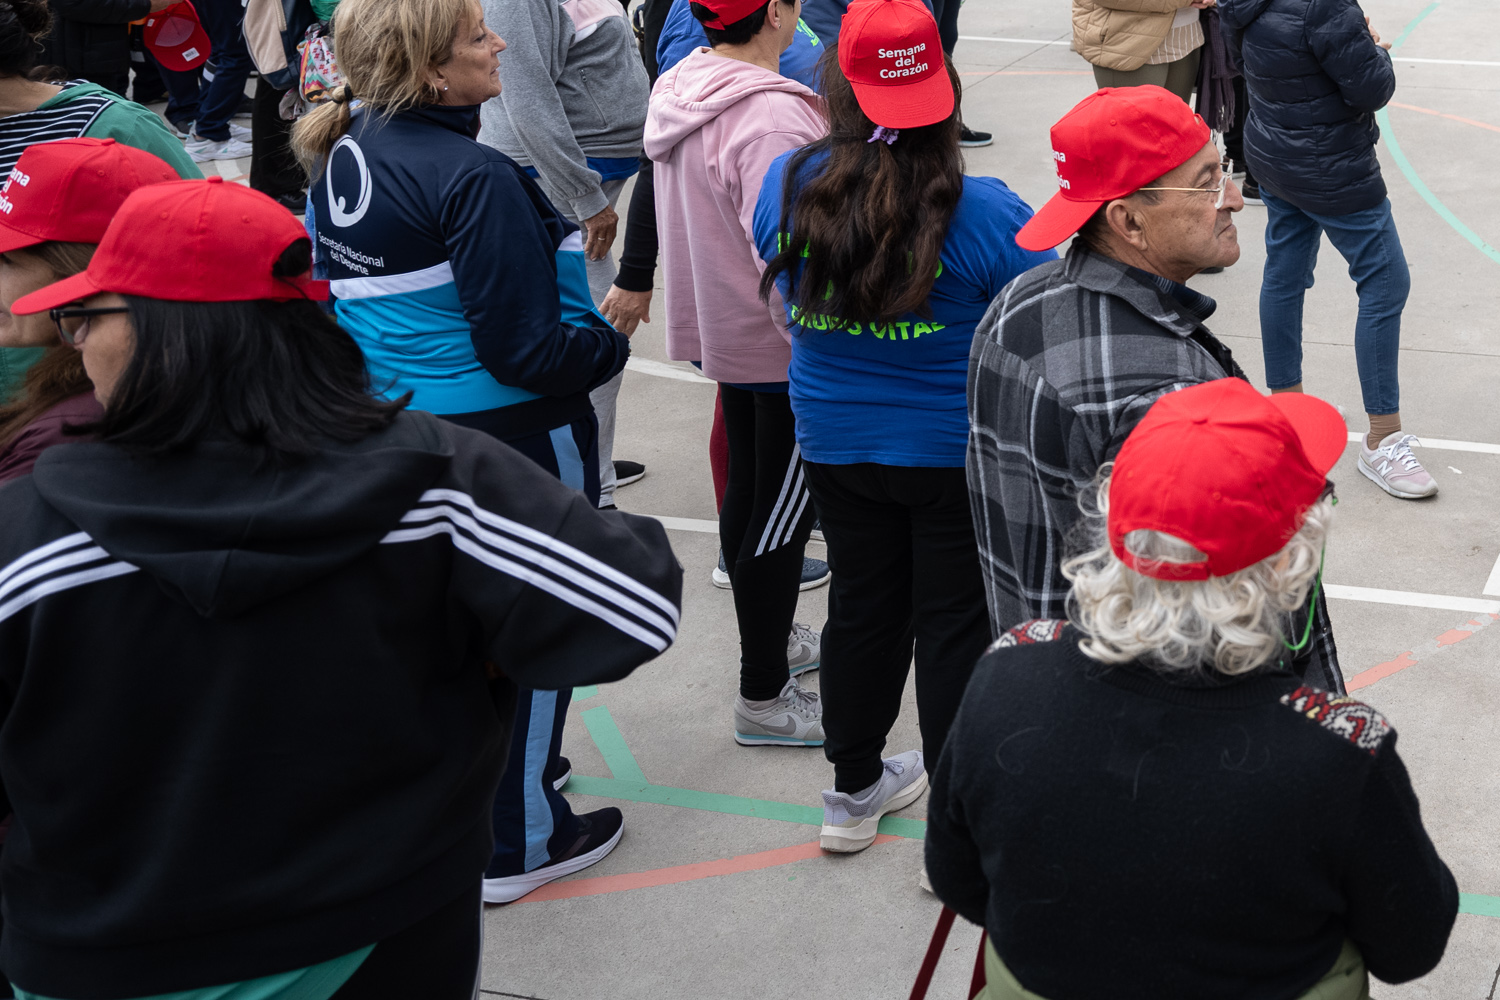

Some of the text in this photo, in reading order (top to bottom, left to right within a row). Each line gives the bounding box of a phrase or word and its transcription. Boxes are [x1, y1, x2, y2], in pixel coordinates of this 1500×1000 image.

[878, 42, 926, 59] Semana
[895, 54, 915, 68] del
[880, 62, 929, 79] Corazón
[318, 231, 385, 268] Secretaría Nacional
[330, 249, 370, 276] del Deporte
